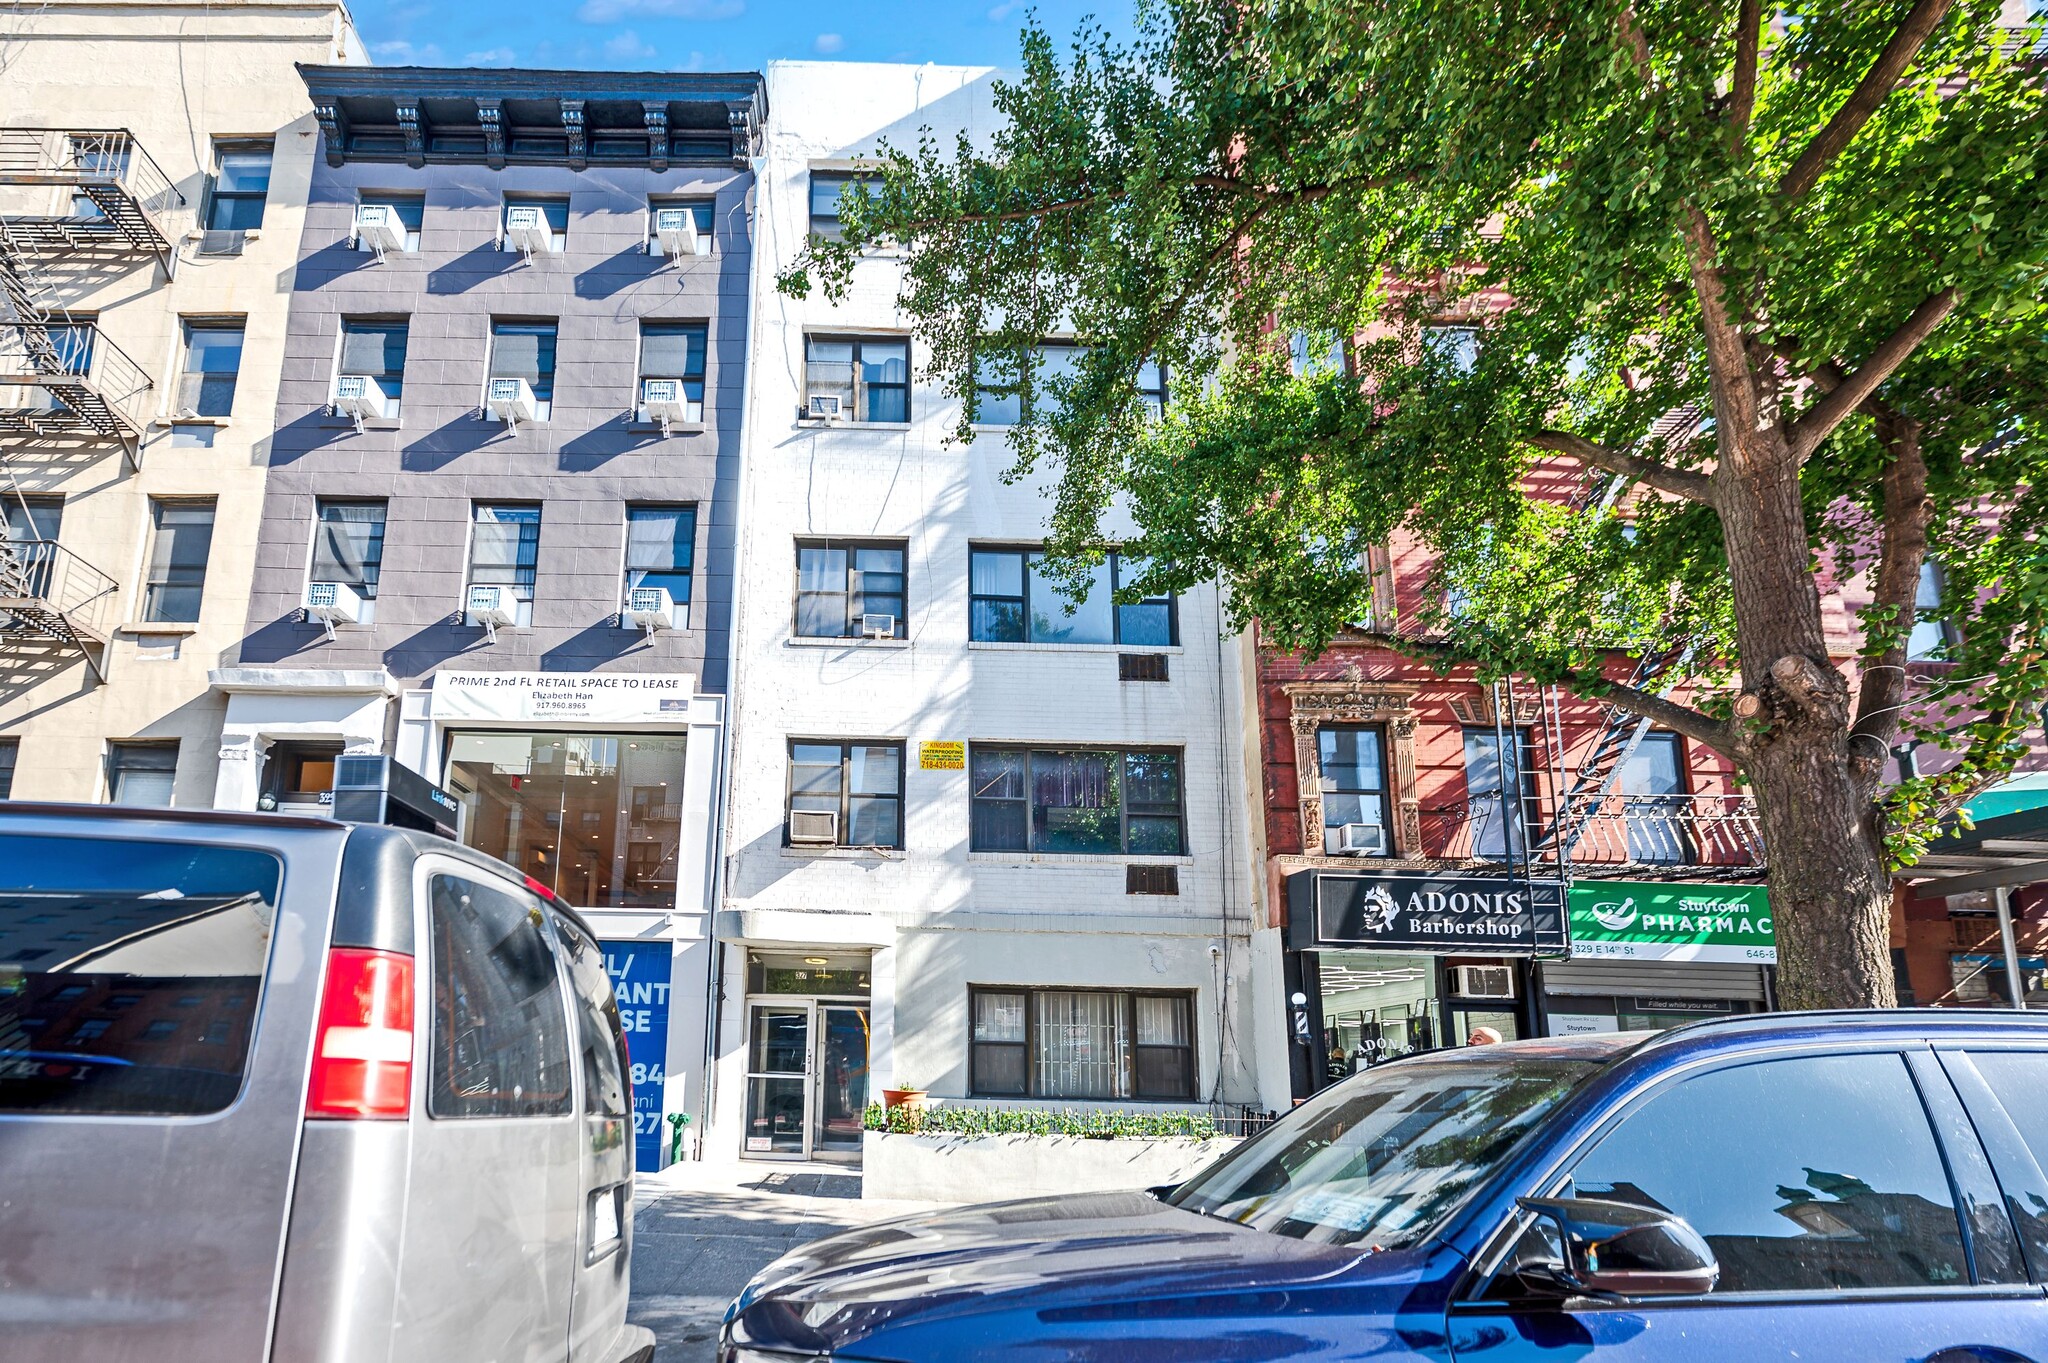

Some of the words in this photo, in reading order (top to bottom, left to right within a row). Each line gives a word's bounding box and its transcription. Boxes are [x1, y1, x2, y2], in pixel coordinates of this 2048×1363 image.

[449, 676, 490, 687] PRIME
[493, 676, 517, 687] 2nd
[520, 677, 533, 687] FL
[536, 678, 577, 688] RETAIL
[580, 678, 619, 688] SPACE
[622, 679, 639, 689] TO
[642, 679, 679, 689] LEASE
[532, 691, 573, 700] Elizabeth
[575, 692, 593, 700] Han
[536, 701, 586, 710] 917.960.8965
[921, 760, 964, 769] 718-434-0020
[431, 789, 457, 812] LinkNYC
[1405, 891, 1523, 914] ADONIS
[1678, 899, 1750, 914] Stuytown
[1409, 918, 1522, 939] Barbershop
[1642, 914, 1773, 935] PHARMAC
[1574, 944, 1593, 953] 329
[1596, 945, 1602, 954] E
[1605, 945, 1622, 954] 14th
[1624, 946, 1635, 955] St
[1746, 949, 1776, 959] 646-8
[615, 982, 671, 1005] ANT
[1648, 1000, 1667, 1008] Filled
[620, 1009, 652, 1033] SE
[1566, 1024, 1597, 1032] Stuytown
[632, 1062, 666, 1086] 84
[634, 1112, 662, 1135] 27
